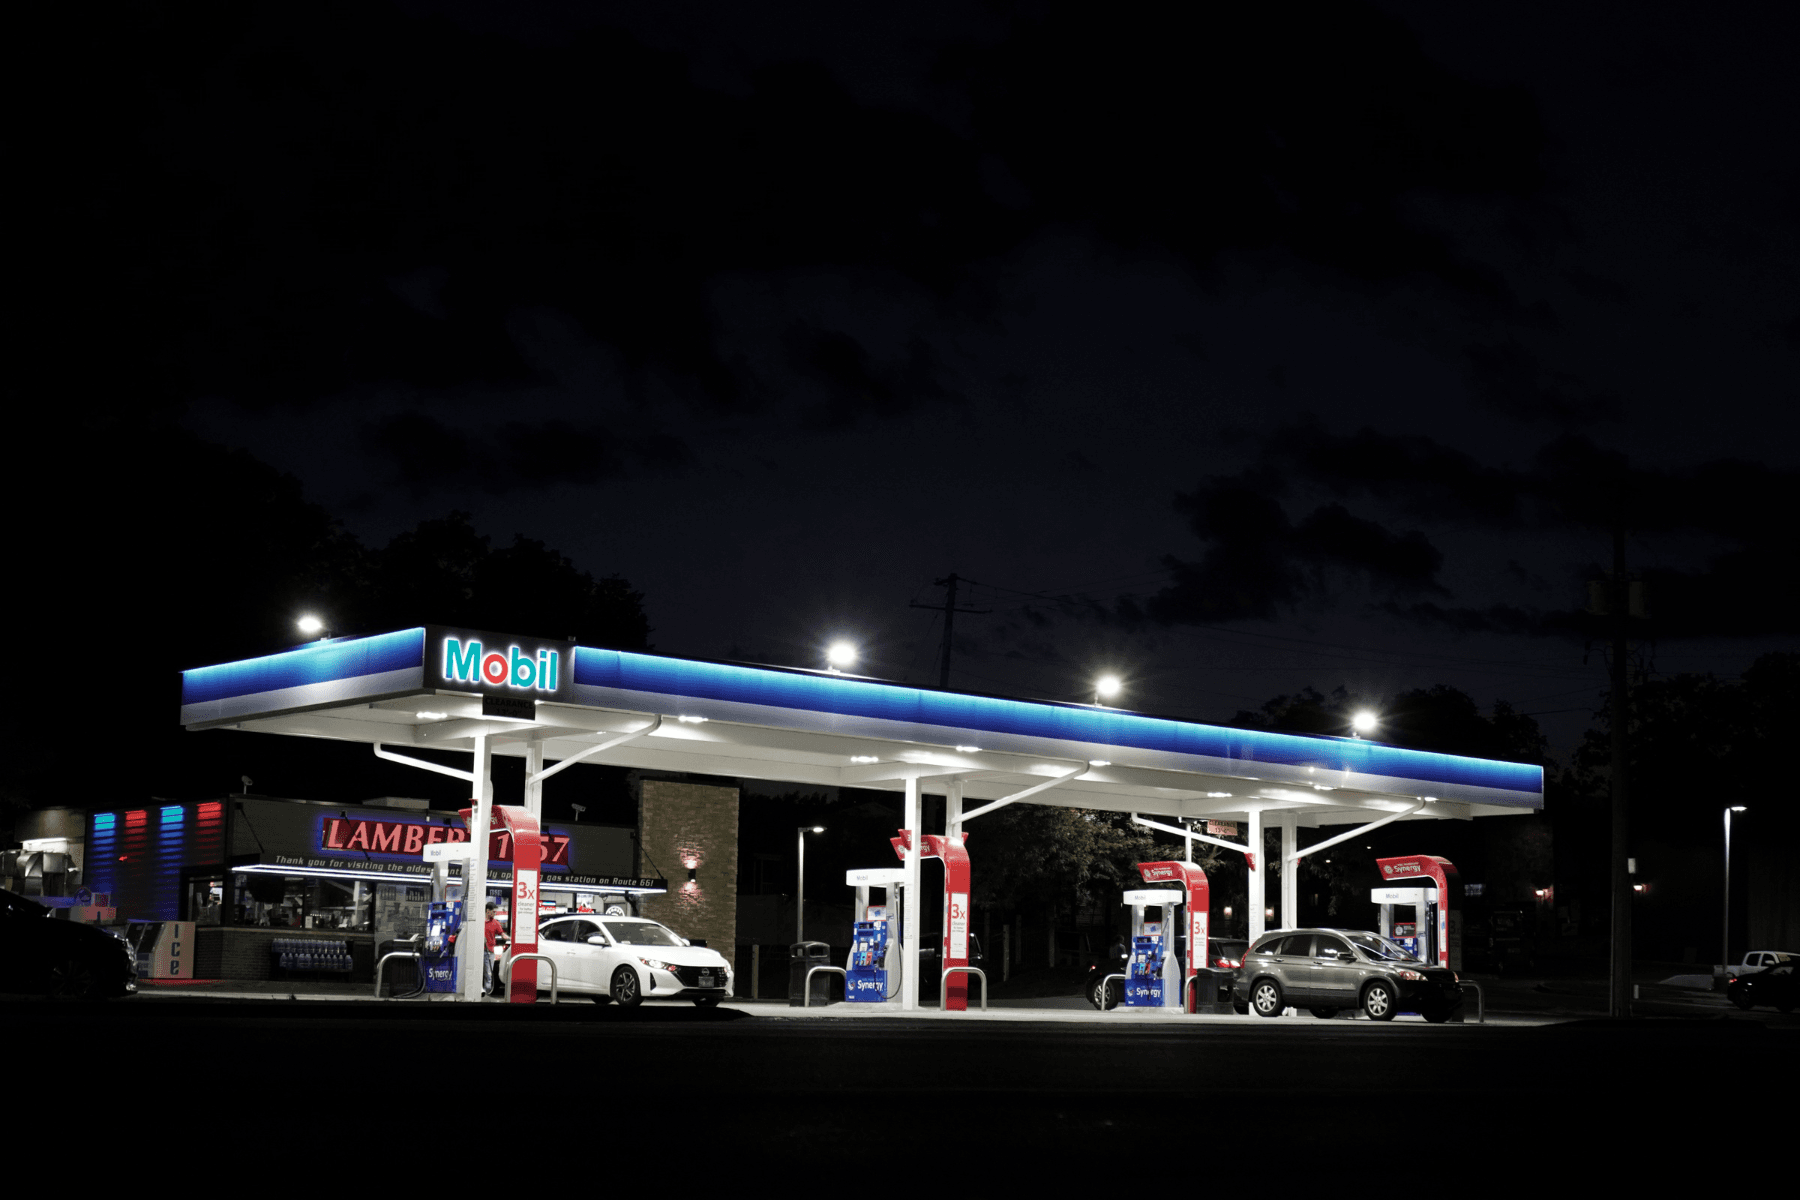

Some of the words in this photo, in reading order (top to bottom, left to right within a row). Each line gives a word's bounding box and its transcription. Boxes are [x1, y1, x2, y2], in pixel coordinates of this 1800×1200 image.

[445, 639, 557, 690] Mobil
[485, 697, 533, 709] CLEARANCE
[496, 832, 571, 862] 157
[275, 855, 304, 865] Thank
[307, 859, 326, 867] you
[329, 859, 344, 867] for
[347, 861, 384, 872] visiting
[387, 863, 403, 872] the
[406, 864, 432, 873] oldes
[546, 874, 562, 883] gas
[565, 875, 596, 884] station
[612, 877, 636, 886] Route
[639, 879, 654, 887] 66!
[517, 881, 535, 899] 3x
[951, 903, 966, 919] 3x
